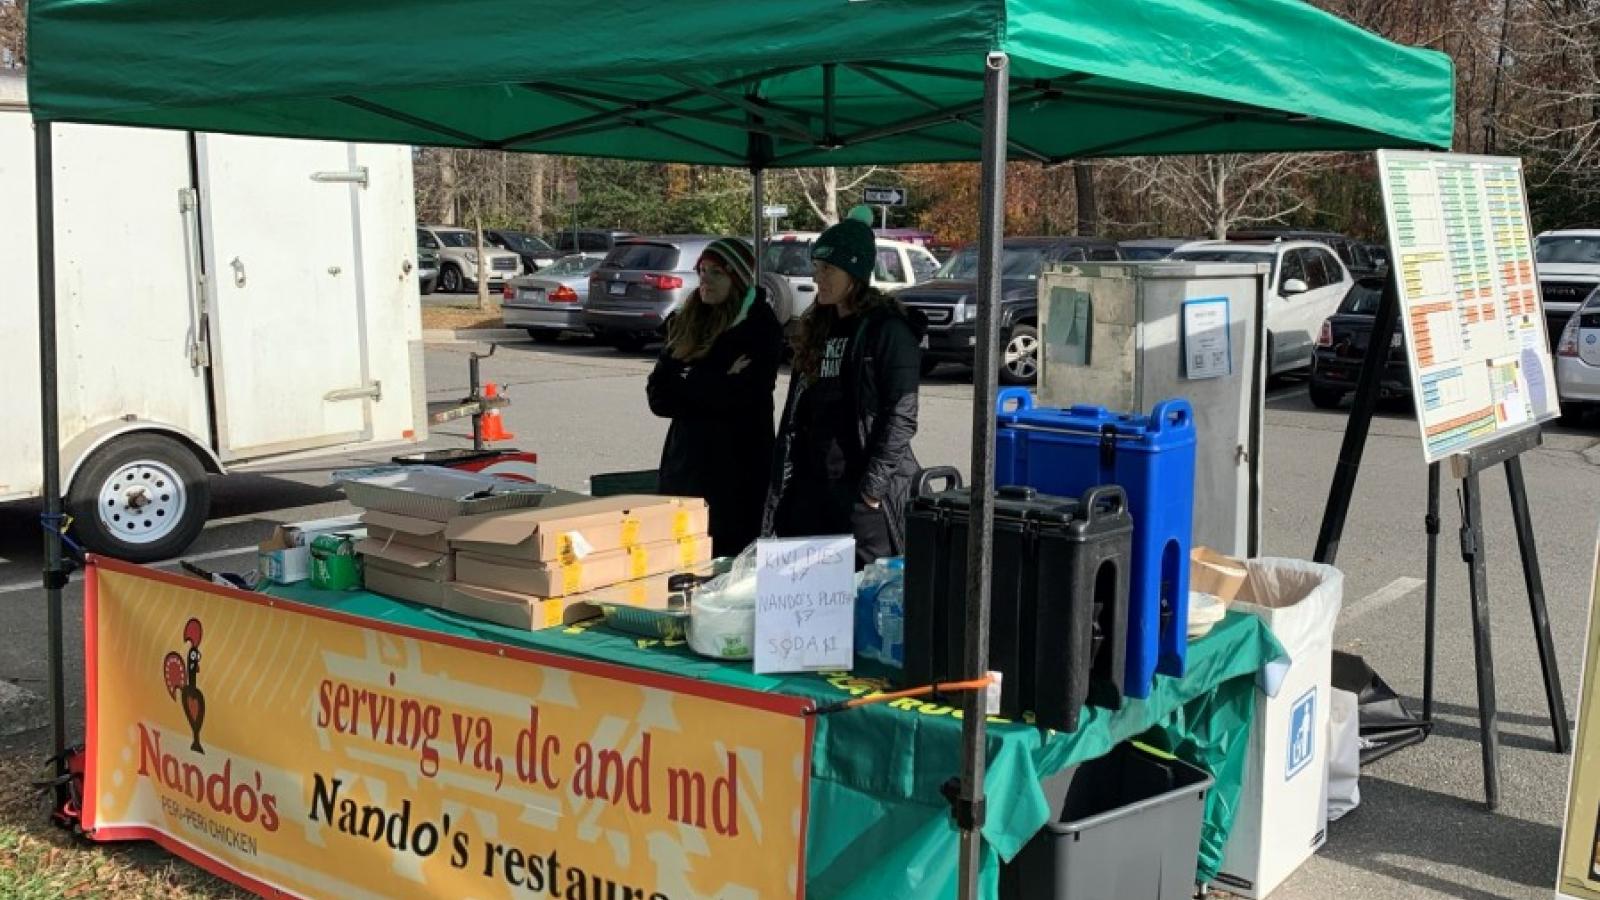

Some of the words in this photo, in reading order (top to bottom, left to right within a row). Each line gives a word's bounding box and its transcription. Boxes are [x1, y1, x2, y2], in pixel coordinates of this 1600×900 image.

[769, 635, 818, 657] SODA
[137, 722, 279, 832] Nando's
[317, 672, 441, 778] serving
[452, 713, 503, 792] va,
[516, 705, 560, 790] dc
[573, 731, 651, 814] and
[667, 751, 739, 837] md
[208, 819, 258, 857] CHICKEN
[308, 772, 469, 869] Nando's
[483, 841, 669, 900] restau
